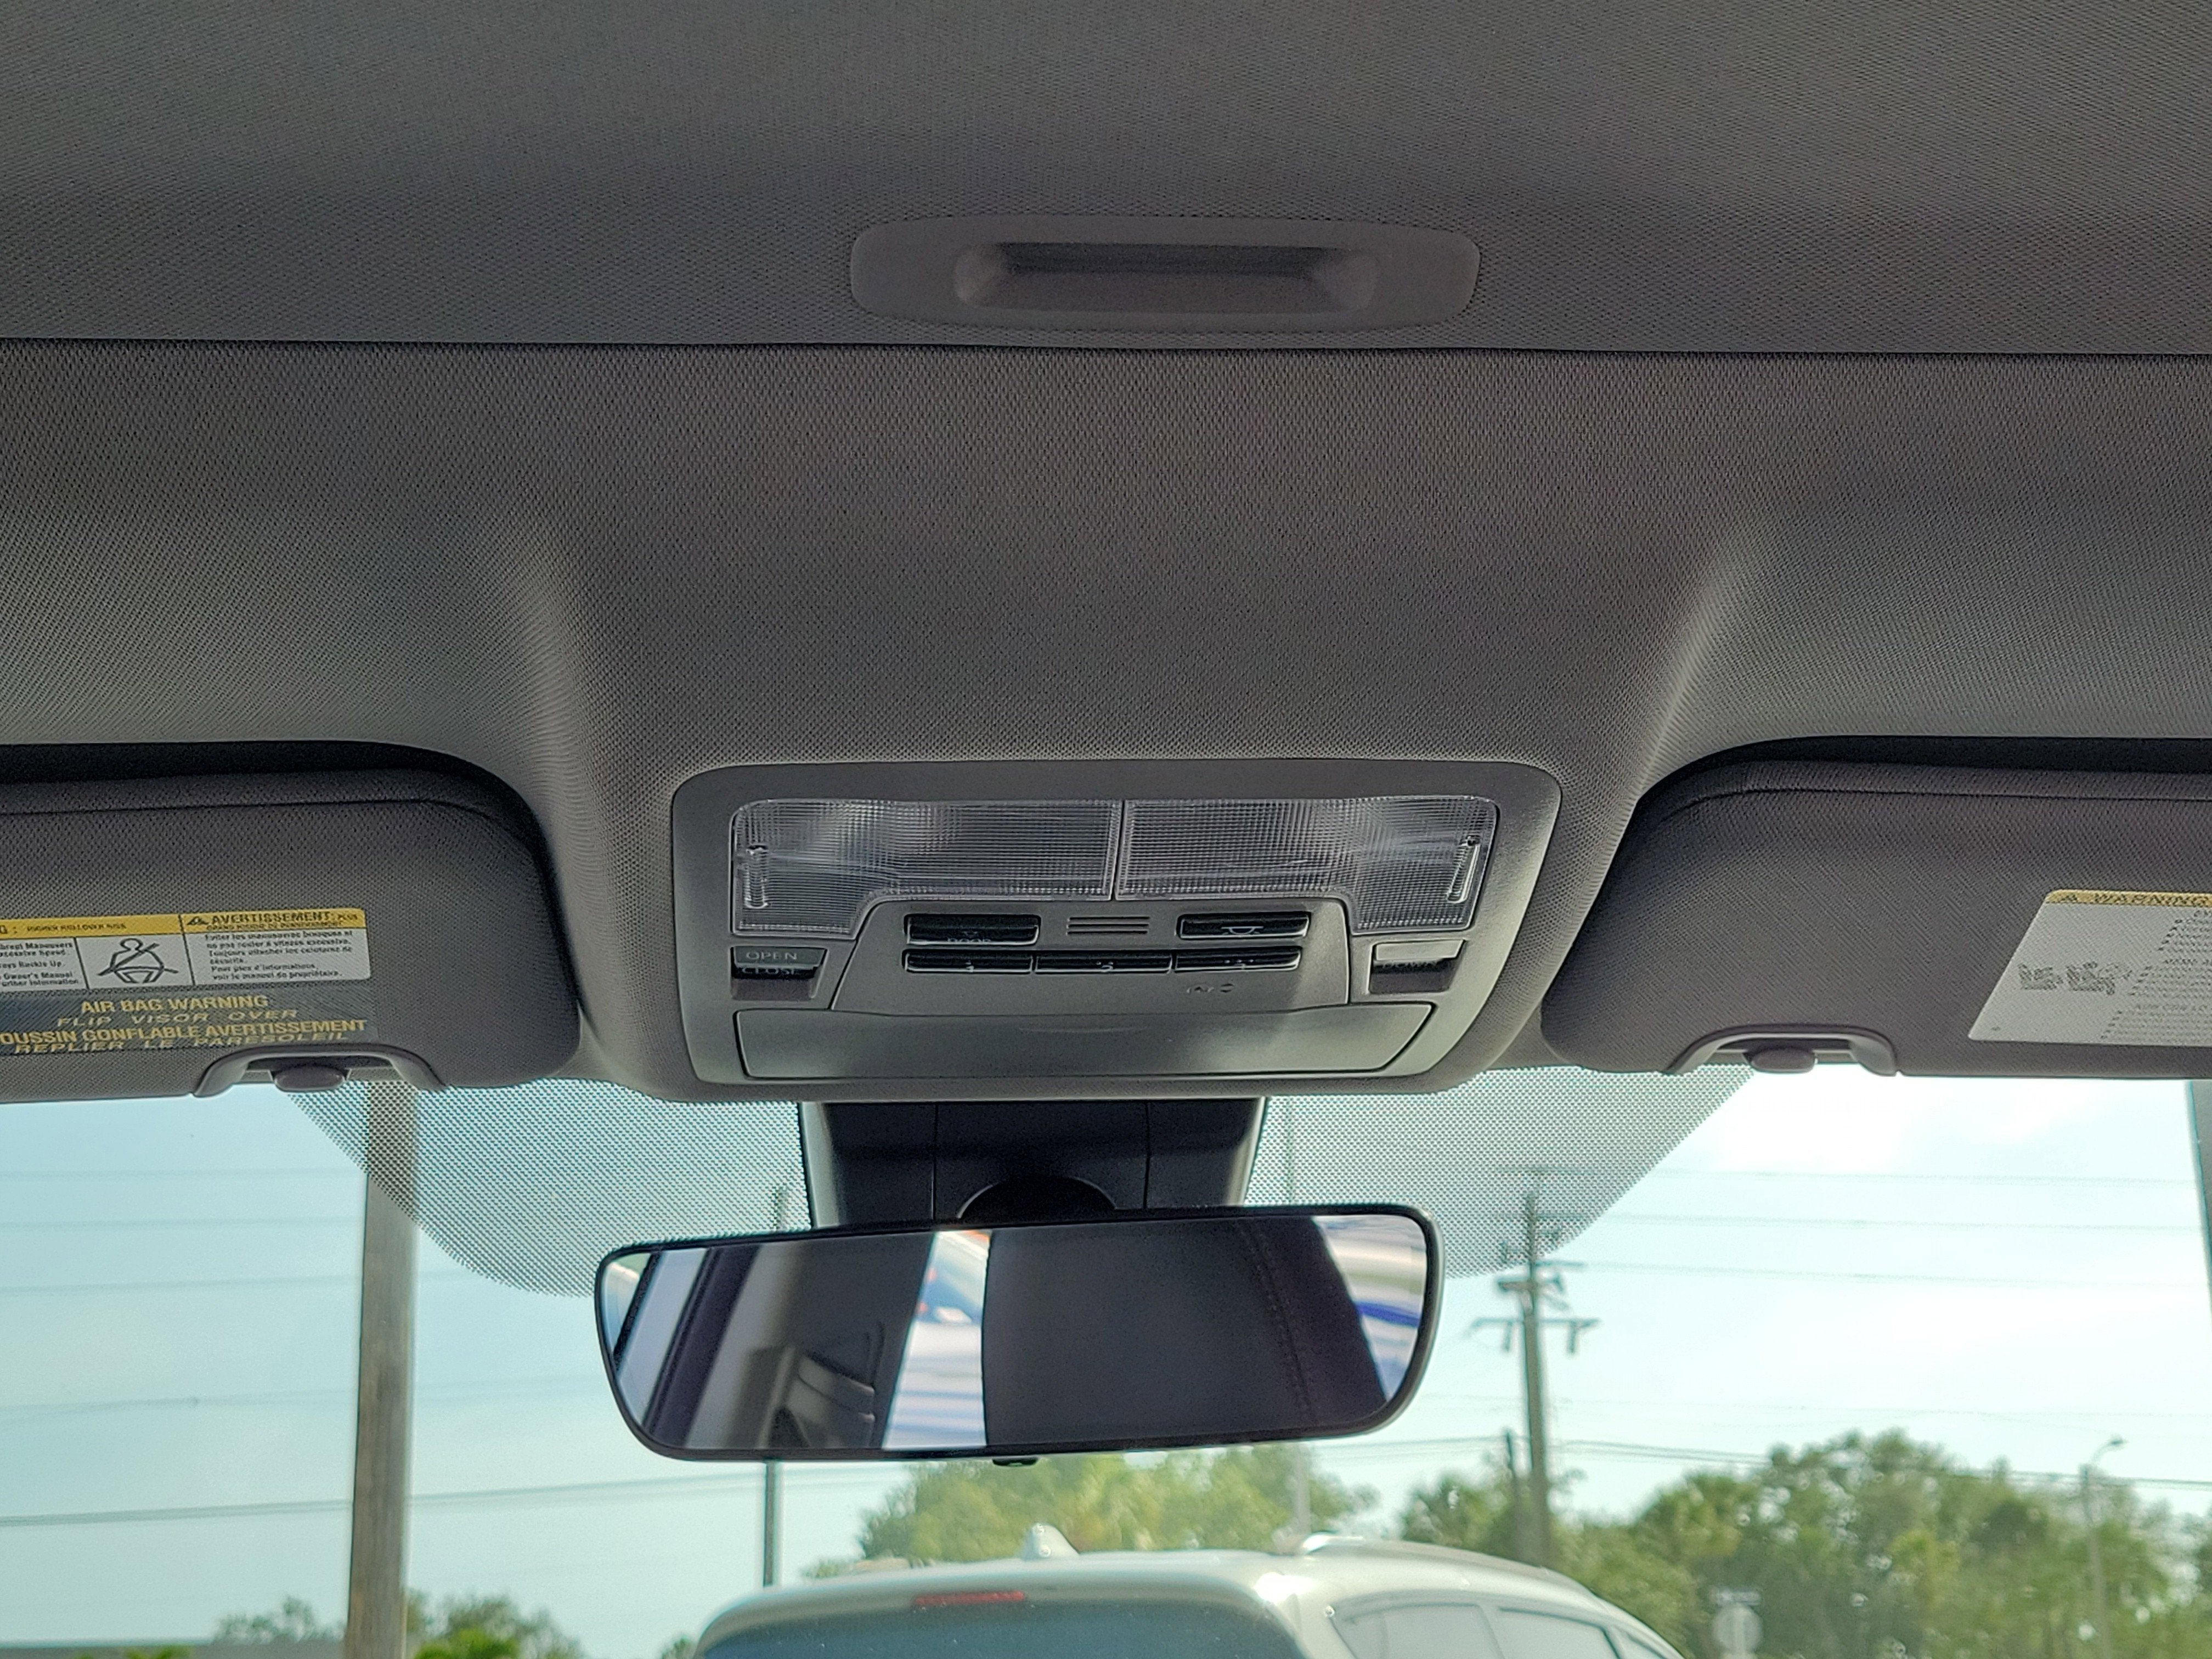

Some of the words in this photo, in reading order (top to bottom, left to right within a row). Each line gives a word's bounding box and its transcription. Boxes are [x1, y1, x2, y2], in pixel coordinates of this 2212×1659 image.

[746, 951, 797, 960] OPEN
[82, 1001, 115, 1013] AIR
[120, 998, 163, 1012] BAG
[167, 995, 268, 1011] WARNING
[131, 1013, 210, 1024] VISOR
[228, 1009, 297, 1020] OVER
[82, 1026, 199, 1042] GONFLABLE
[205, 1019, 367, 1037] AVERTISSEMENT
[15, 1041, 125, 1054] REPLIER
[144, 1039, 174, 1049] LE
